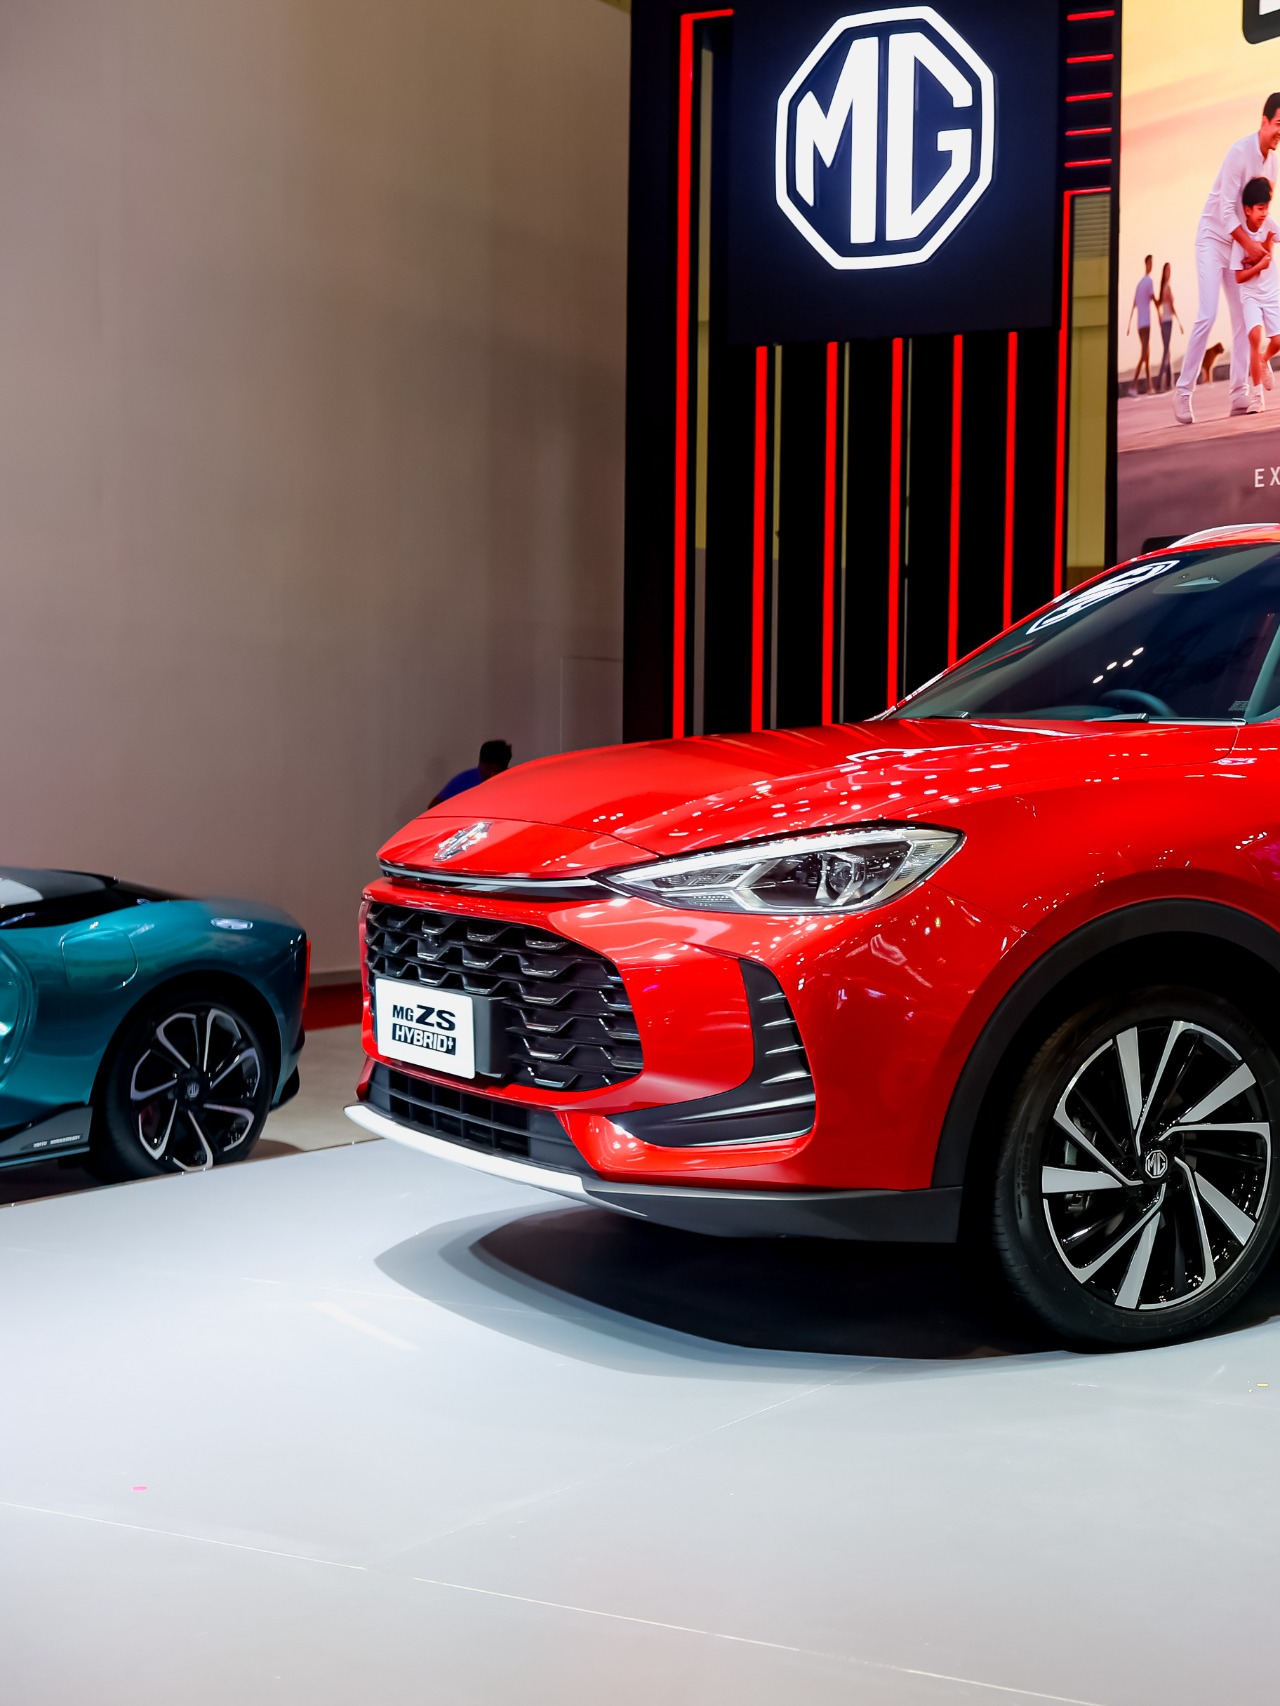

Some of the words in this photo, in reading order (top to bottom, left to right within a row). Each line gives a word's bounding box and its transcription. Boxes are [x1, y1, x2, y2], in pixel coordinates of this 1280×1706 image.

[794, 31, 974, 245] MG
[392, 1004, 414, 1022] MG
[416, 1004, 456, 1031] ZS
[1146, 1151, 1167, 1177] MG
